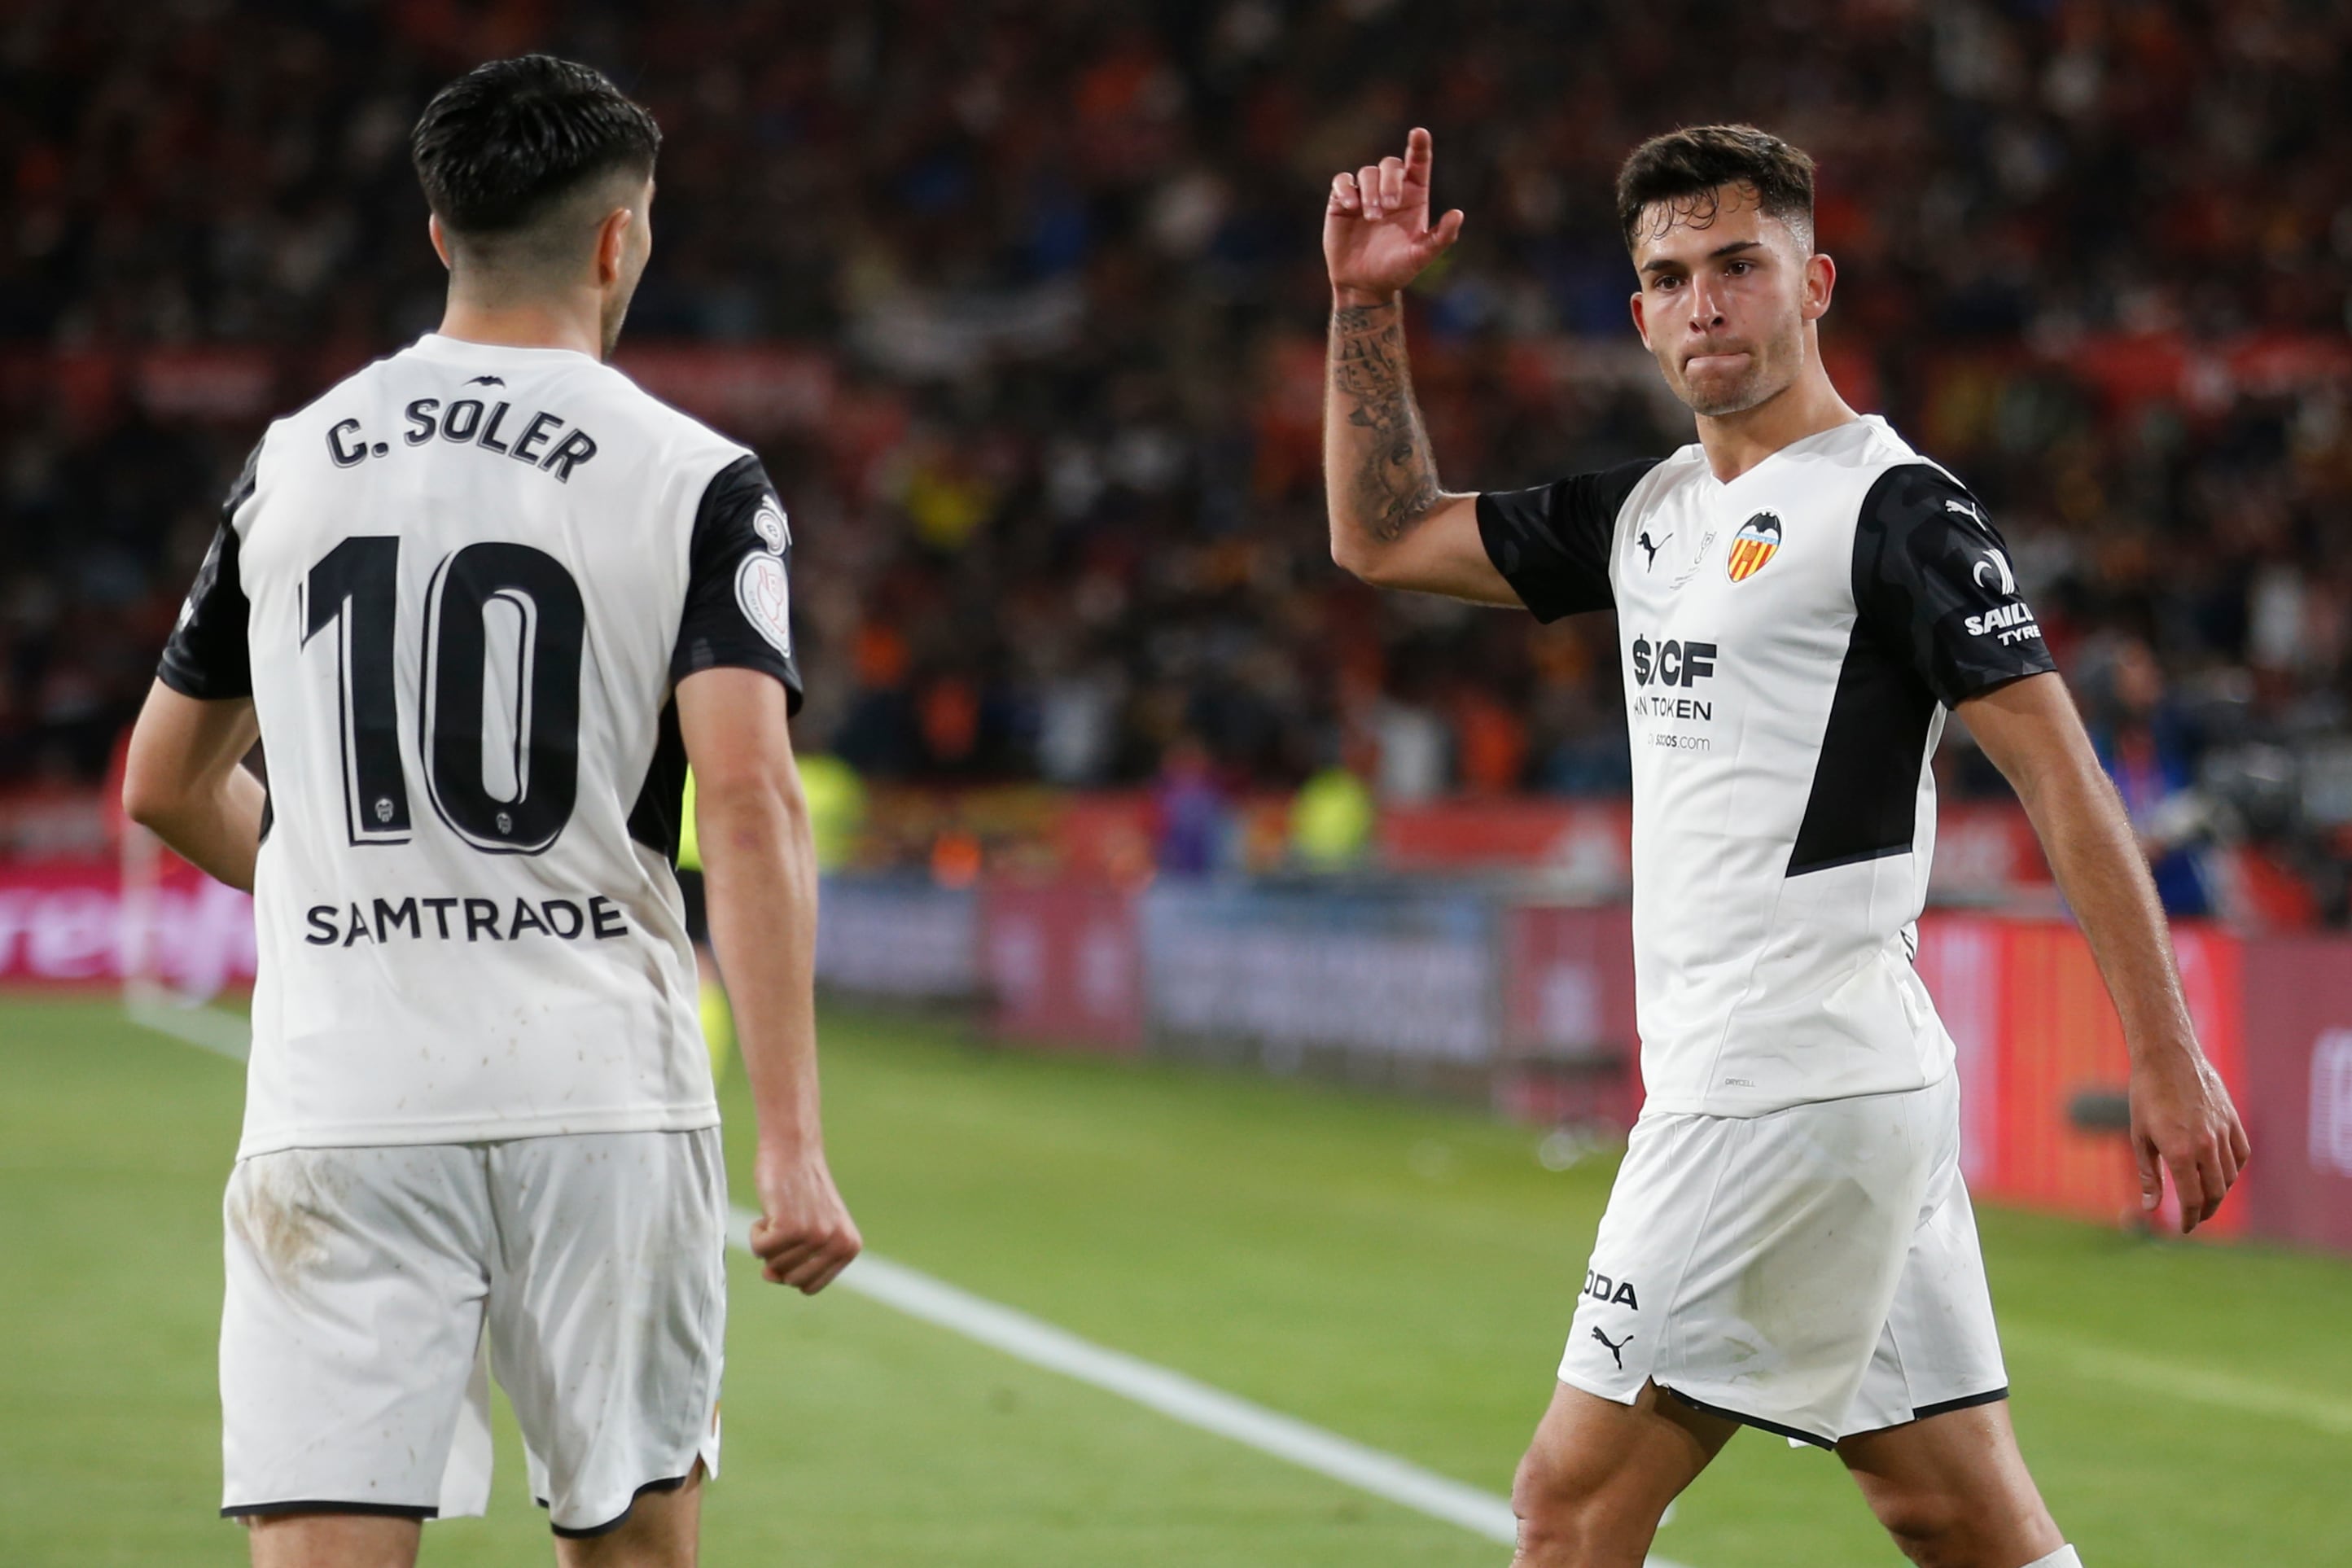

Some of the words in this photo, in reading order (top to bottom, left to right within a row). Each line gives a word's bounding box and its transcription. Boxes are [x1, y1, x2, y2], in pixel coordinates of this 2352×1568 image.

[326, 418, 389, 469] C.
[404, 398, 598, 484] SOLER
[299, 536, 585, 856] 10
[1651, 697, 1711, 720] TOKEN
[304, 896, 629, 948] SAMTRADE
